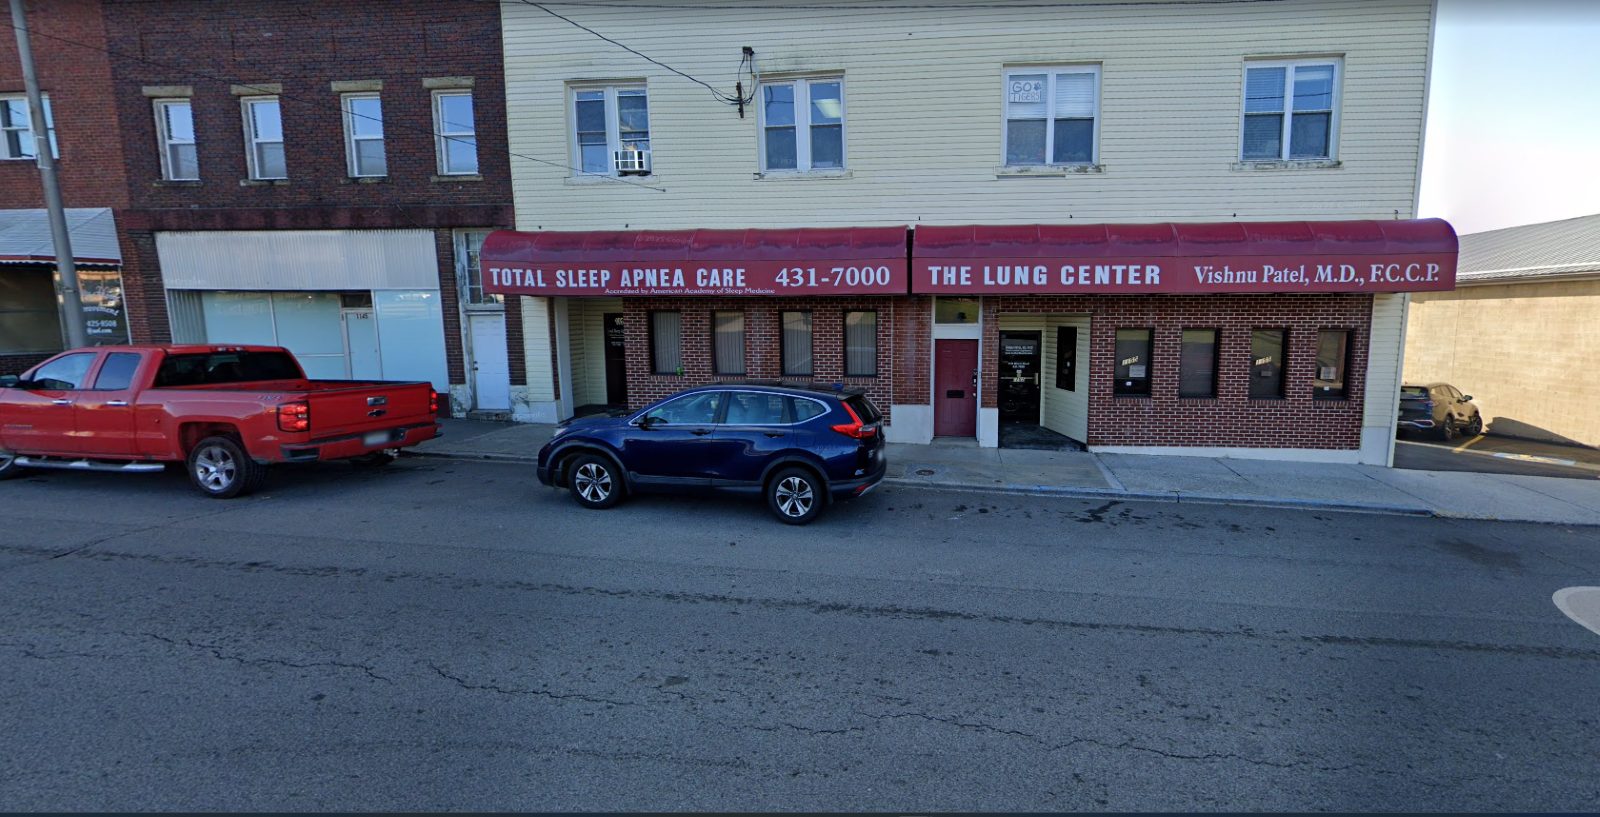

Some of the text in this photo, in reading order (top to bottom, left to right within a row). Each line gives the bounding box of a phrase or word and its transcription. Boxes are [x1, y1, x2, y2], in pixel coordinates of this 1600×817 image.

[1010, 92, 1040, 102] TIGERS
[1012, 82, 1032, 92] GO
[489, 267, 746, 288] TOTAL SLEEP APNEA CARE
[775, 266, 890, 287] 431-7000
[928, 265, 1161, 286] THE LUNG CENTER
[1194, 263, 1440, 286] Vishnu Patel, M.D., F.C.C.P.
[640, 287, 648, 295] by
[684, 287, 715, 295] Academy
[725, 287, 744, 295] Sleep
